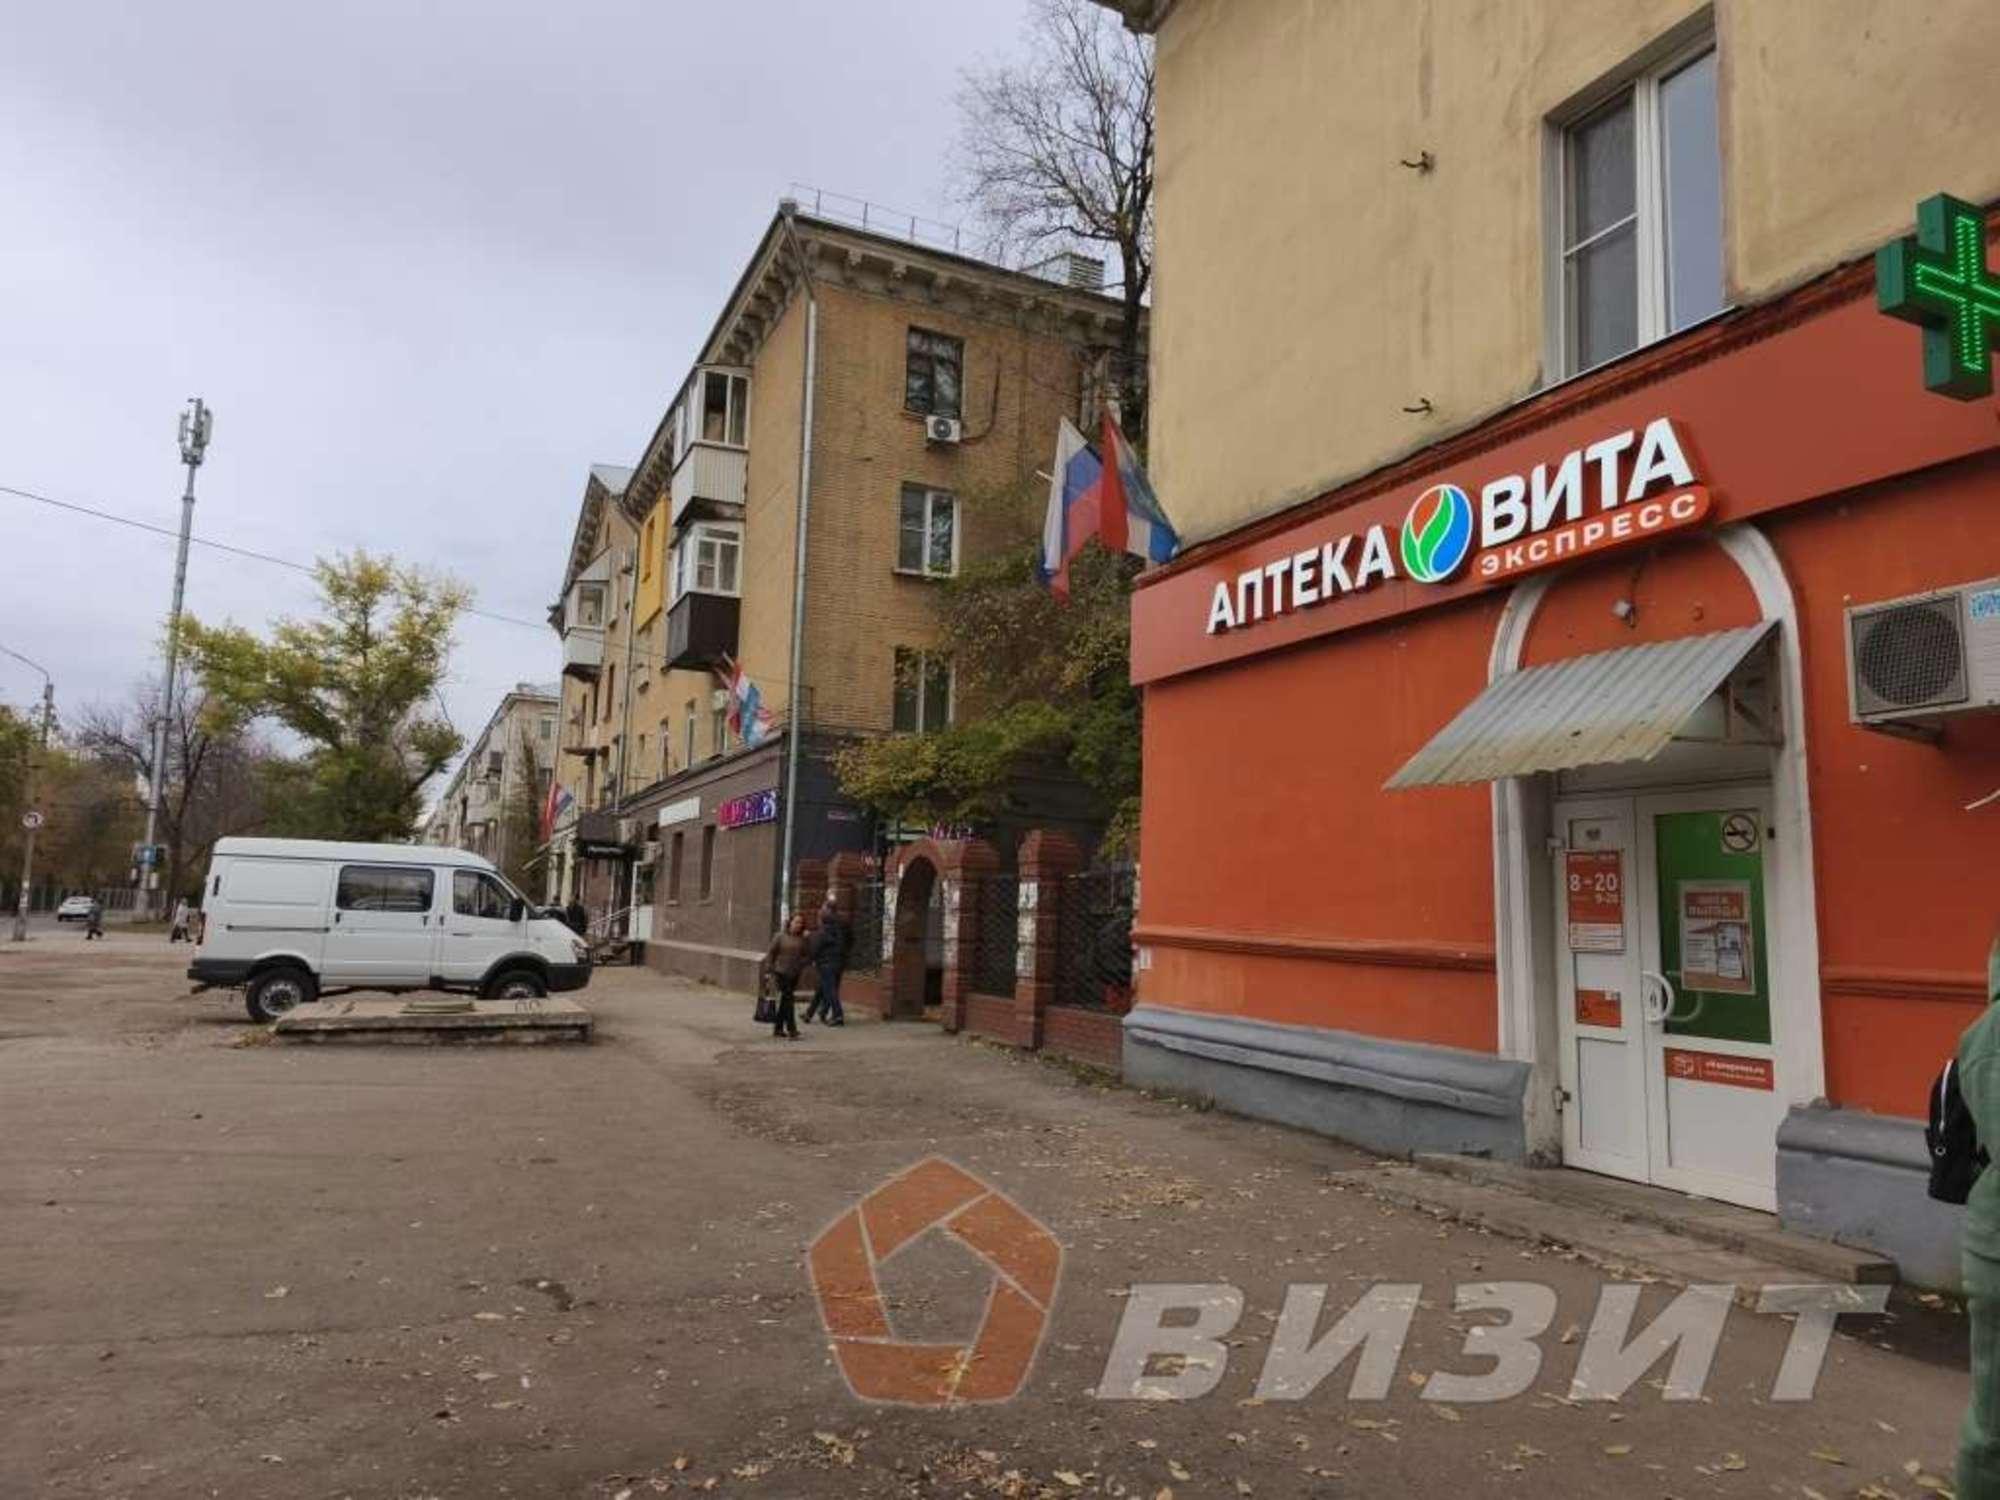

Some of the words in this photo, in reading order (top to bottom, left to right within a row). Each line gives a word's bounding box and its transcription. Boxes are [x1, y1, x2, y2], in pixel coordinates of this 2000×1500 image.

[1206, 524, 1396, 634] АПТЕКА
[1481, 417, 1697, 547] ВИТА
[1480, 493, 1699, 577] ЭКСПРЕСС
